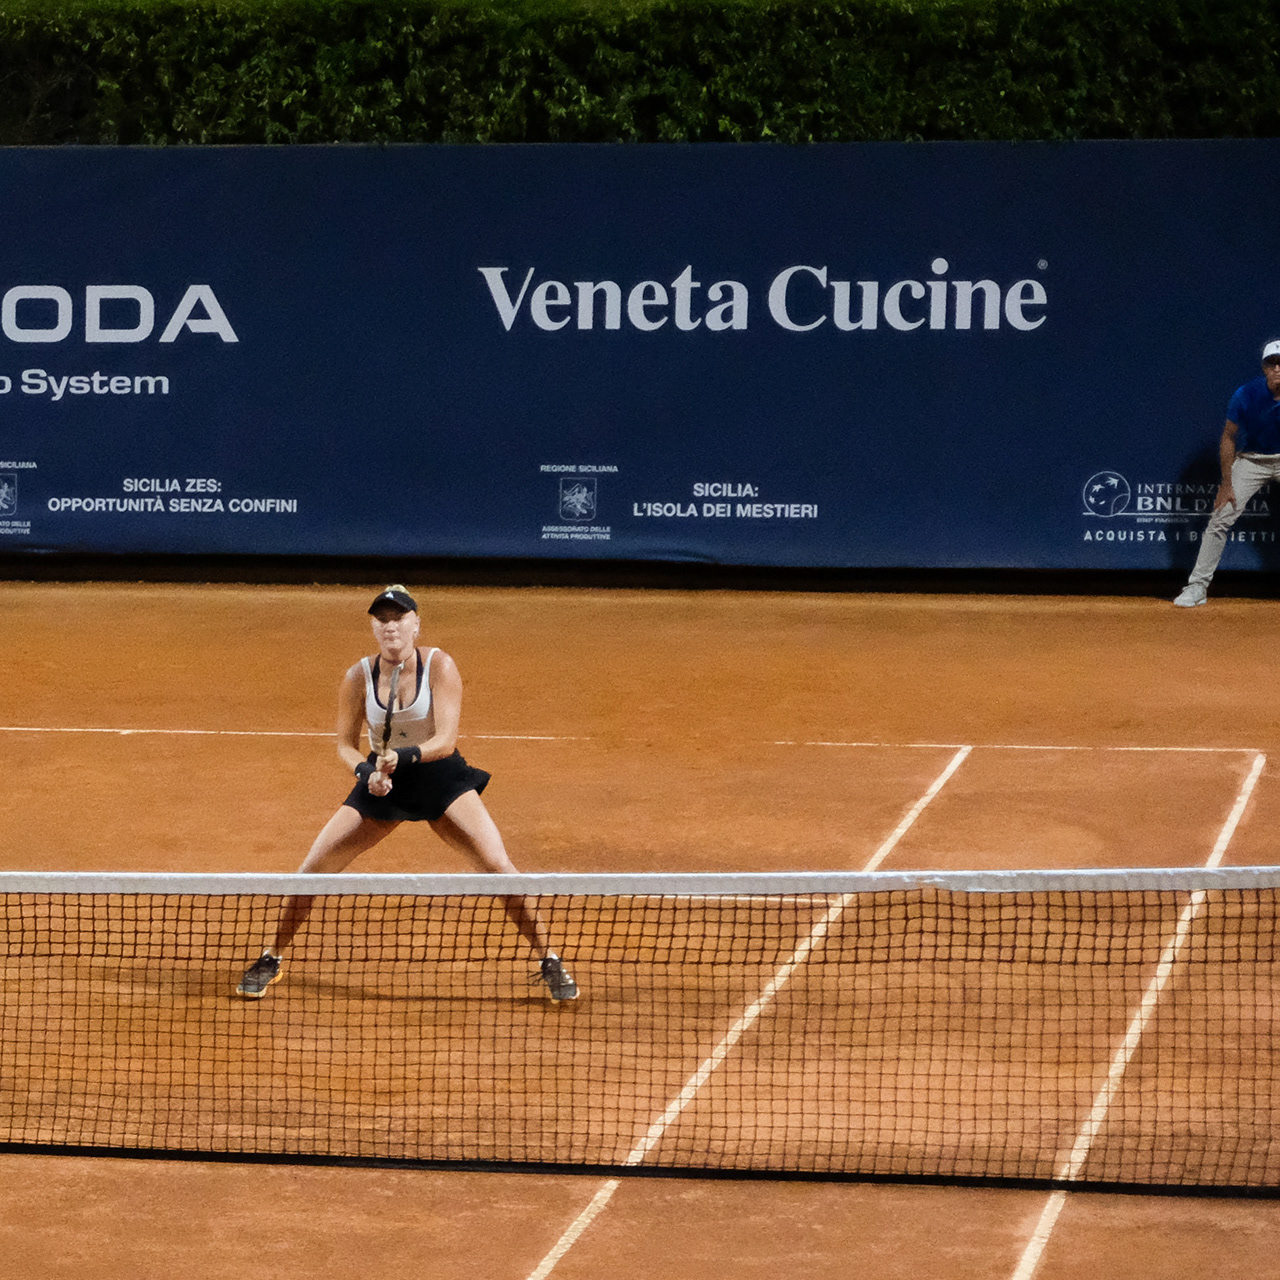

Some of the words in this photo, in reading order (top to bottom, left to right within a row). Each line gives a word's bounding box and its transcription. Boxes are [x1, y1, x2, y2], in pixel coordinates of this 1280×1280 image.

[477, 264, 749, 332] Veneta
[768, 257, 1048, 332] Cucine
[20, 368, 170, 401] System
[0, 460, 38, 469] SICILIANA
[539, 464, 577, 473] REGIONE
[578, 464, 619, 473] SICILIANA
[122, 478, 181, 493] SICILIA
[185, 478, 222, 493] ZES:
[692, 482, 759, 498] SICILIA:
[47, 495, 165, 513] OPPORTUNITÀ
[168, 498, 225, 513] SENZA
[228, 498, 298, 513] CONFINI
[702, 503, 732, 518] DEI
[736, 503, 818, 518] MESTIERI
[1136, 496, 1189, 512] BNL
[1083, 530, 1167, 542] ACQUISTA
